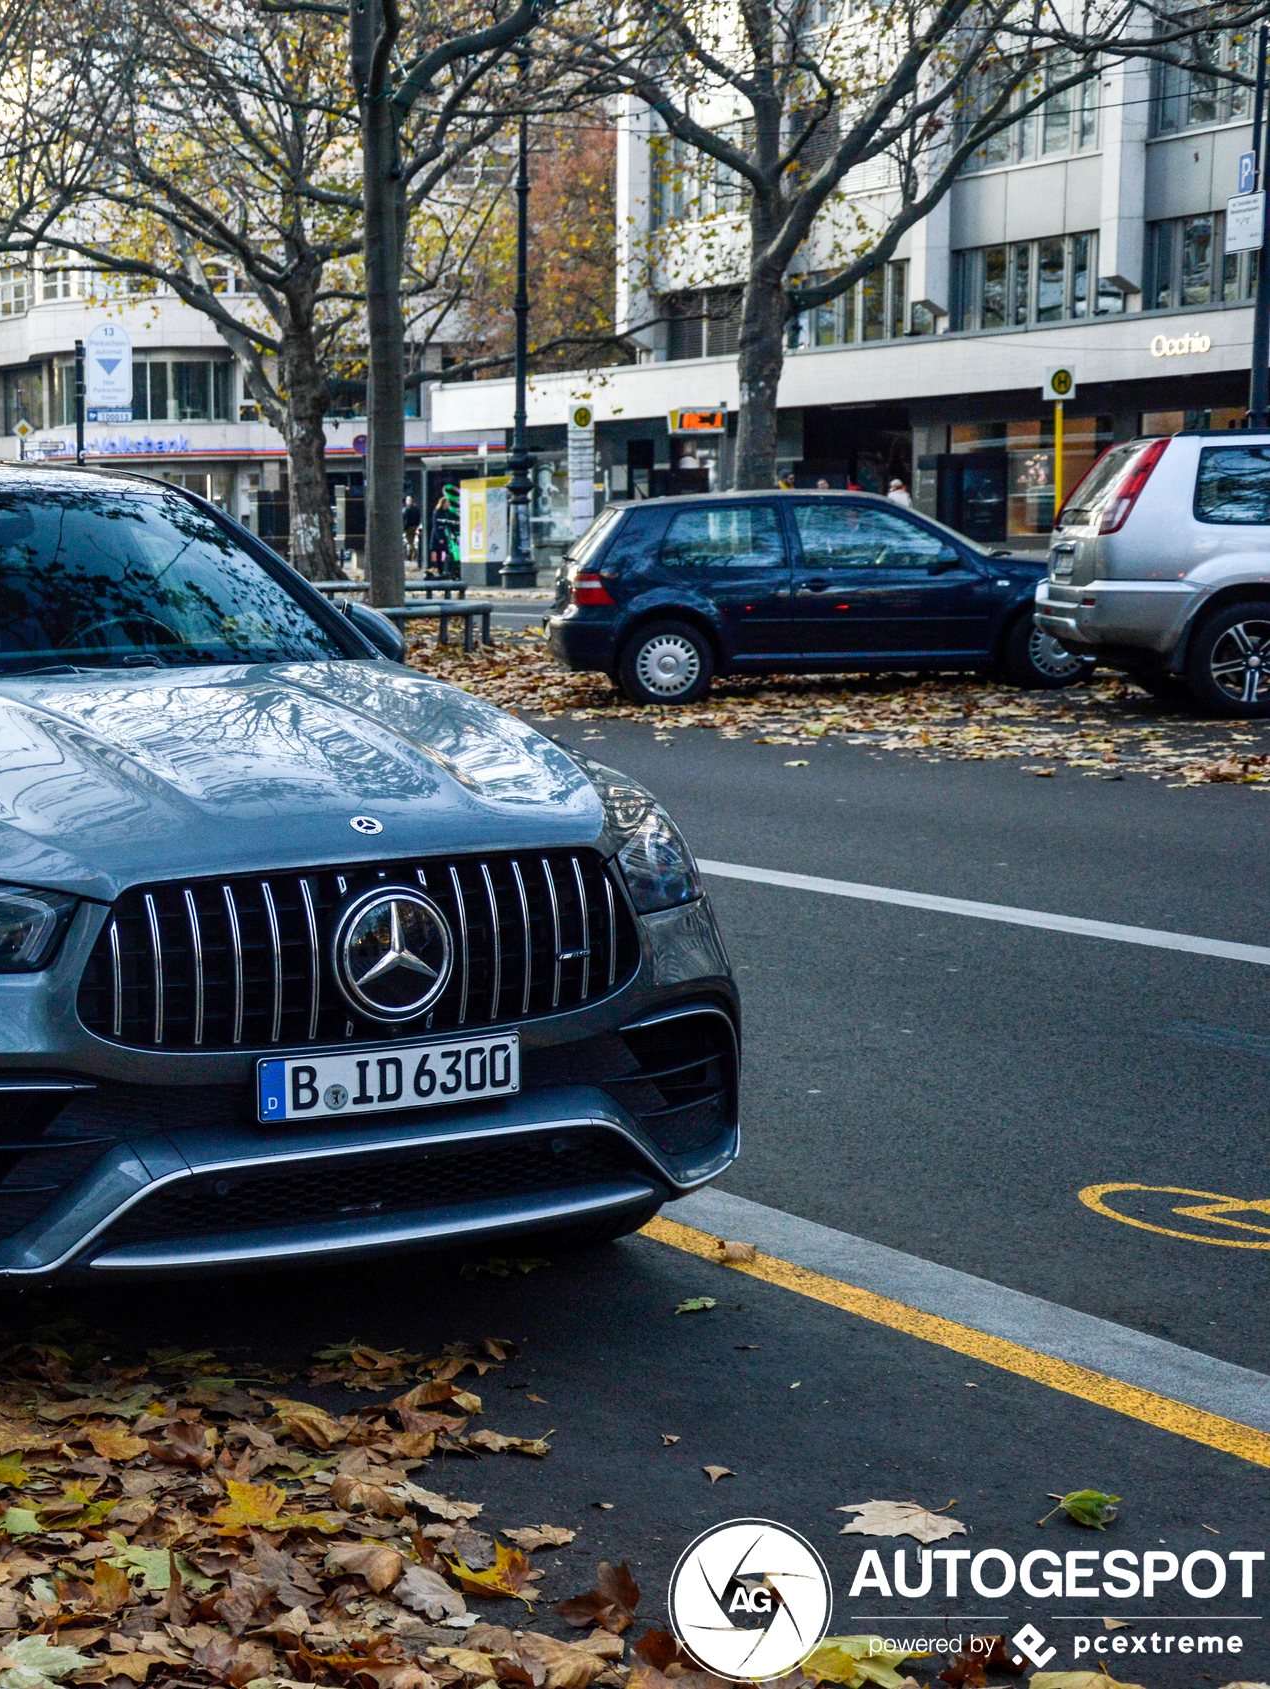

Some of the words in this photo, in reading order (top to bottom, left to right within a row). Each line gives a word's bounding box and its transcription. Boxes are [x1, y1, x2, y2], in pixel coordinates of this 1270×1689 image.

[103, 327, 115, 337] 13
[1150, 331, 1211, 357] Occhio
[92, 386, 126, 394] Parkschein
[95, 433, 189, 454] Volksbank
[292, 1065, 320, 1111] B
[352, 1057, 403, 1105] ID
[414, 1044, 511, 1098] 6300
